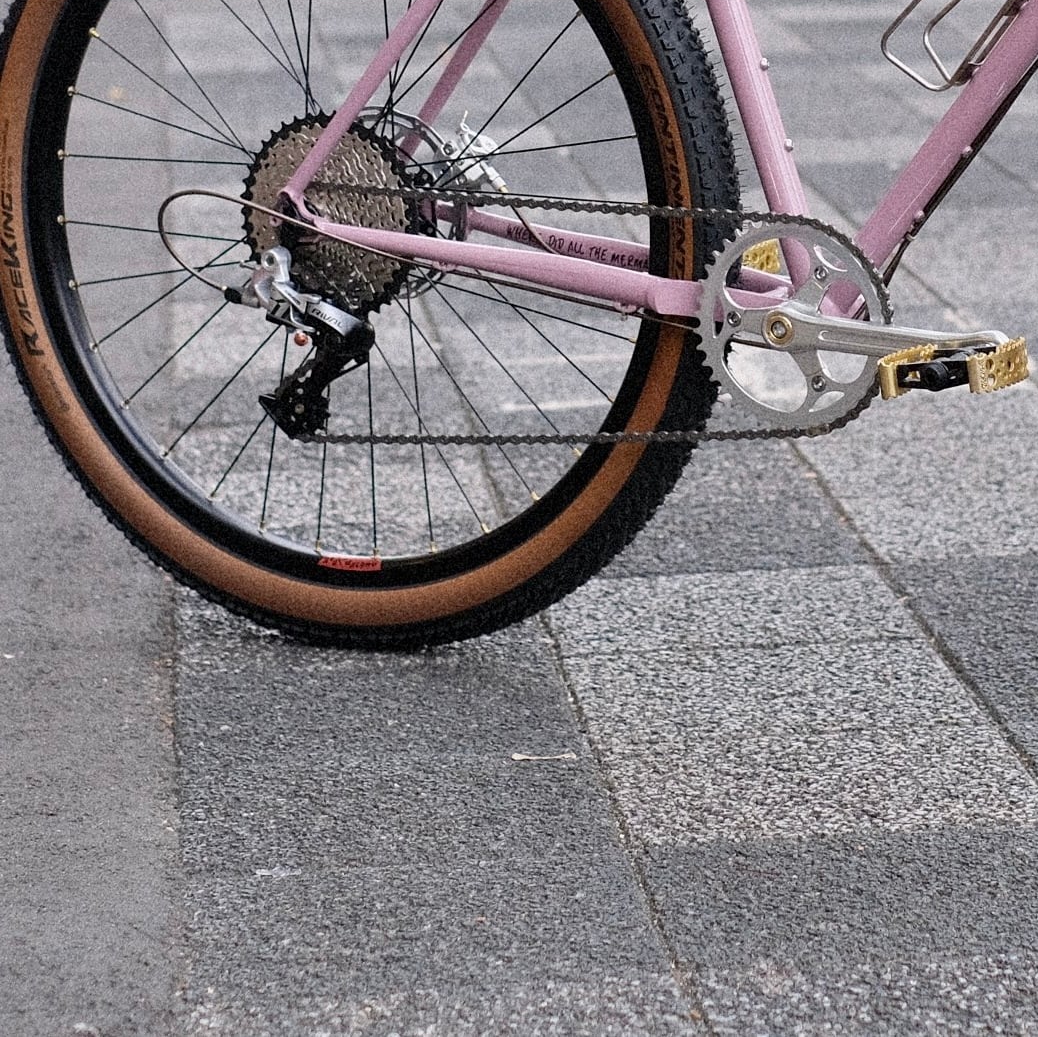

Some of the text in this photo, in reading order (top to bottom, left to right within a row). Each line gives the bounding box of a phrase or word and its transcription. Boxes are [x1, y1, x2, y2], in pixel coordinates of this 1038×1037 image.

[548, 234, 565, 248] DID
[567, 240, 585, 256] ALL
[588, 246, 607, 261] THE
[312, 308, 343, 328] RIVAL
